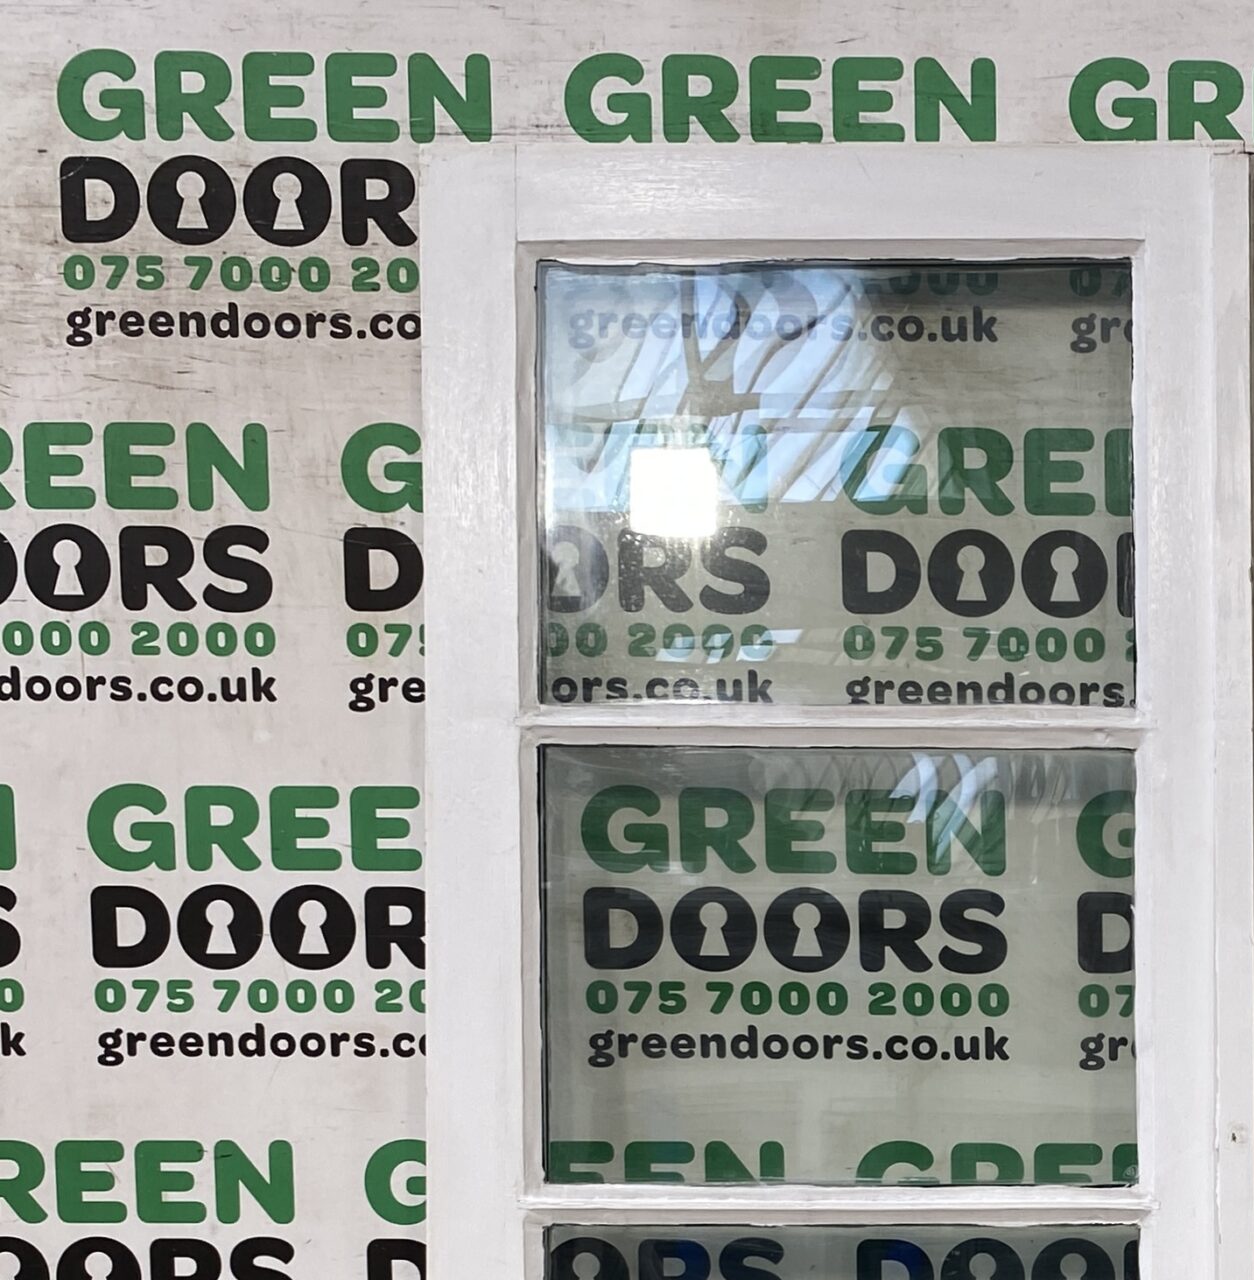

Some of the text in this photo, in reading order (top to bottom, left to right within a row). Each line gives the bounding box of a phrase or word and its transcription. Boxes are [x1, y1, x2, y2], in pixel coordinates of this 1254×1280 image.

[57, 49, 492, 143] GREEN
[564, 53, 996, 143] GREEN
[60, 155, 417, 247] DOOR
[59, 255, 165, 290] 075
[184, 256, 330, 292] 7000
[569, 304, 998, 350] greendoors.co.uk
[0, 422, 269, 511] EEN
[0, 524, 272, 613] ORS
[841, 529, 1131, 618] DOO
[131, 622, 275, 657] 2000
[347, 623, 424, 657] 07
[843, 625, 1105, 662] 075 7000
[87, 783, 422, 872] GREE
[581, 785, 1006, 876] GREEN
[583, 887, 1007, 974] DOORS
[95, 979, 194, 1012] 075
[213, 979, 354, 1013] 7000
[586, 980, 1009, 1017] 075 7000 2000
[98, 1023, 425, 1066] greendoors.c
[588, 1025, 1009, 1068] greendoors.co.uk
